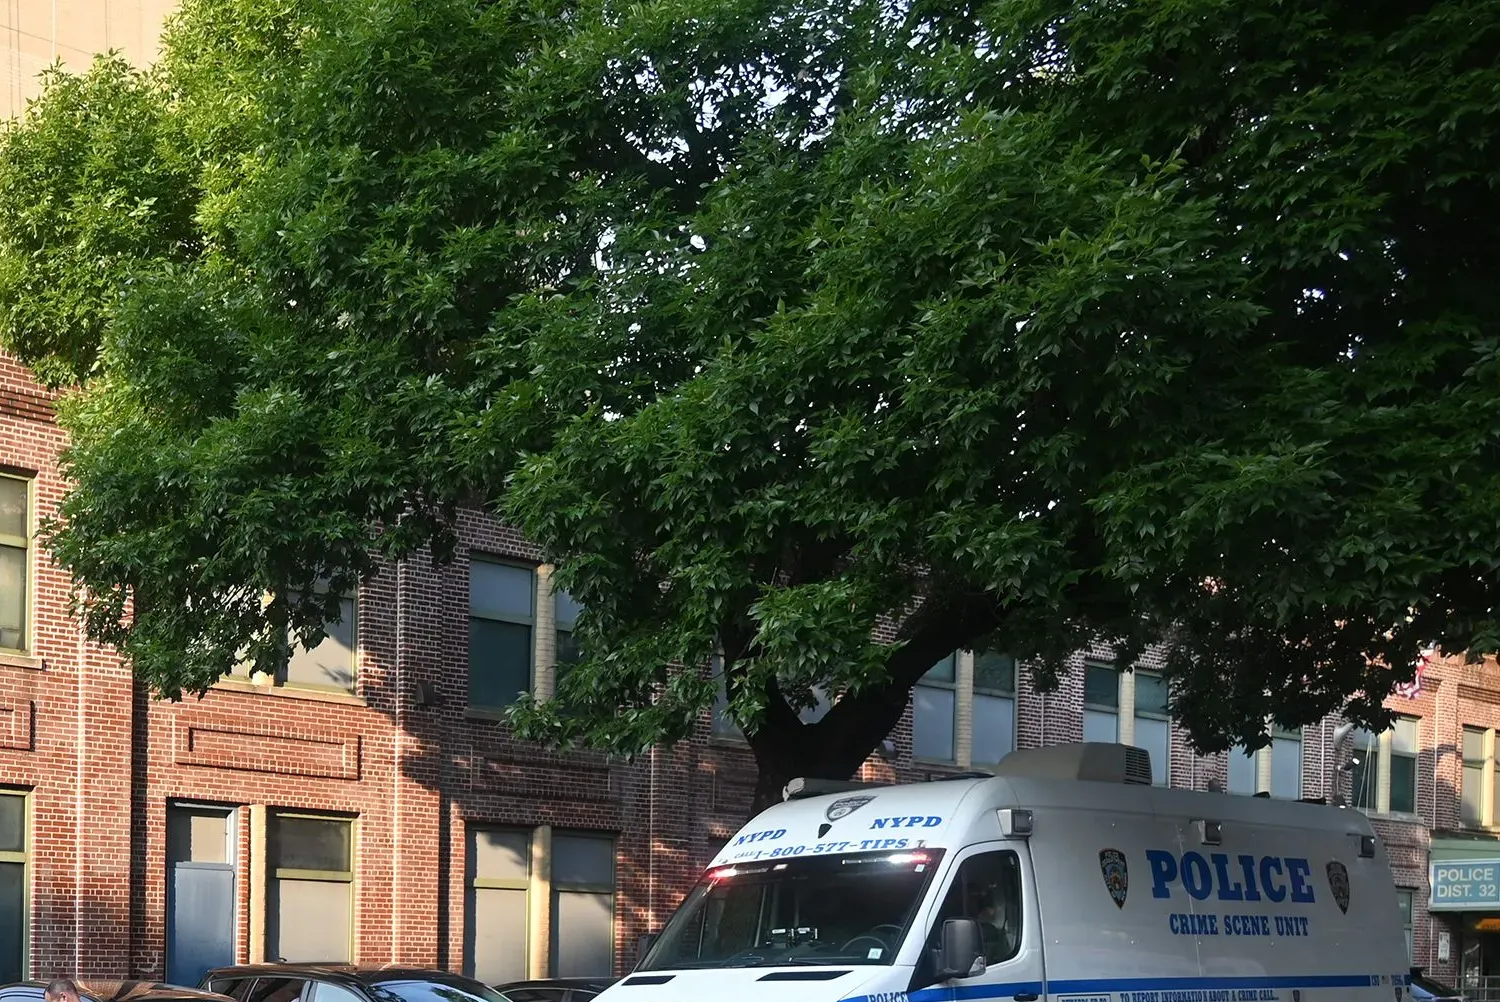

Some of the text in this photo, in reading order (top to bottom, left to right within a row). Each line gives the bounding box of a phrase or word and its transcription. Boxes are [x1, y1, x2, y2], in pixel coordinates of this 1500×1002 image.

[869, 816, 943, 830] NYPD
[732, 829, 787, 846] NYPD
[753, 838, 909, 860] 1-800-577-TIPS
[1146, 849, 1316, 903] POLICE
[1438, 867, 1494, 882] POLICE
[1437, 884, 1496, 898] DIST. 32
[1169, 913, 1309, 937] CRIME SCENE UNIT
[1161, 990, 1207, 1002] INFORMATION
[1209, 990, 1229, 1002] ABOUT
[1232, 990, 1236, 1001] A
[1238, 990, 1257, 1001] CRIME
